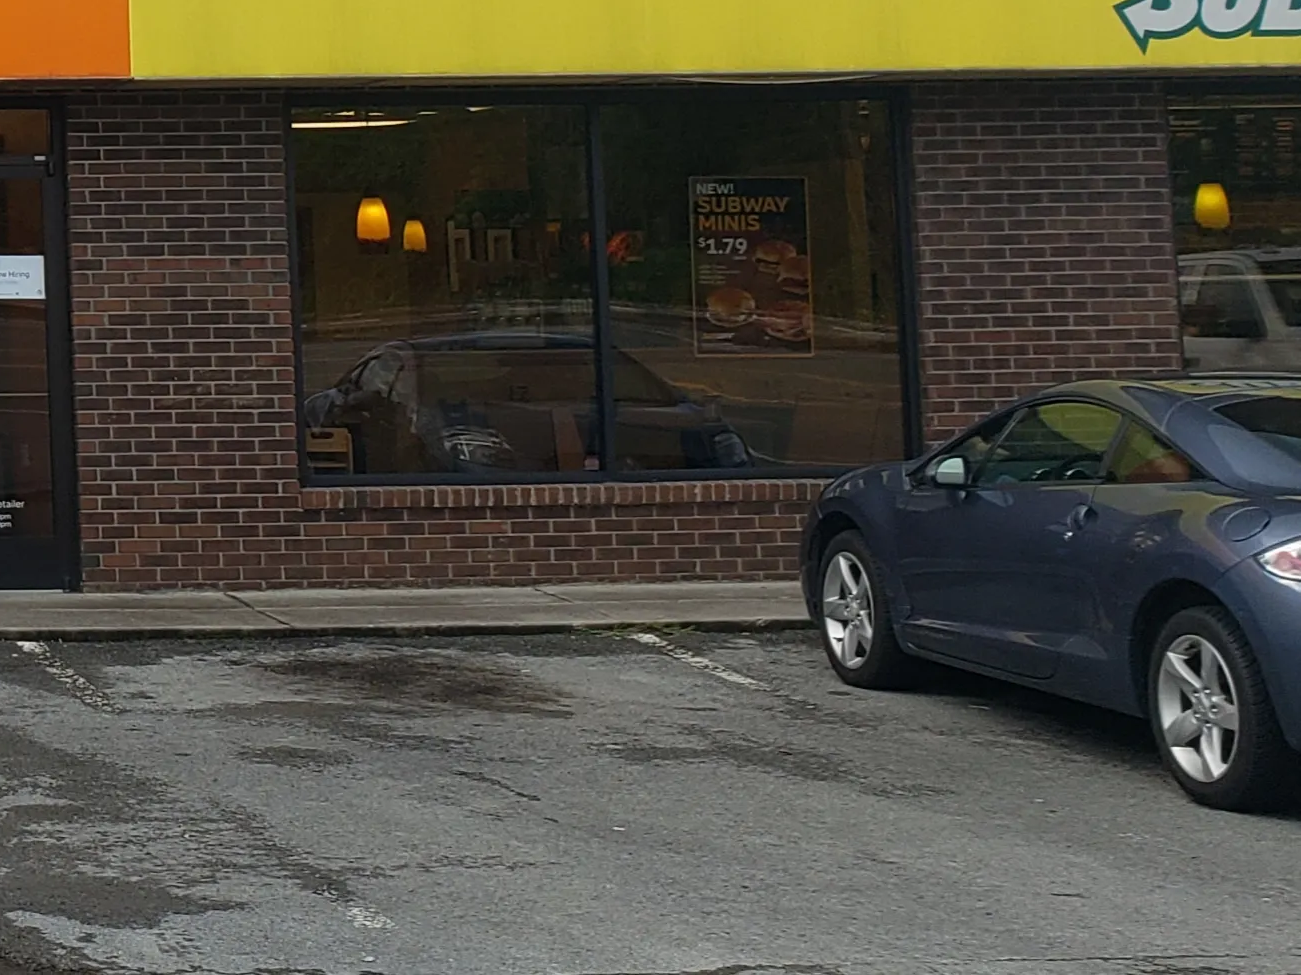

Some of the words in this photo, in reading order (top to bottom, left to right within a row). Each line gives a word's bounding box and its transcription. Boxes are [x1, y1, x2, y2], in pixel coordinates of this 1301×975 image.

[696, 182, 736, 195] NEW!
[696, 195, 791, 213] SUBWAY
[697, 214, 761, 232] MINIS
[696, 236, 748, 255] $1.79
